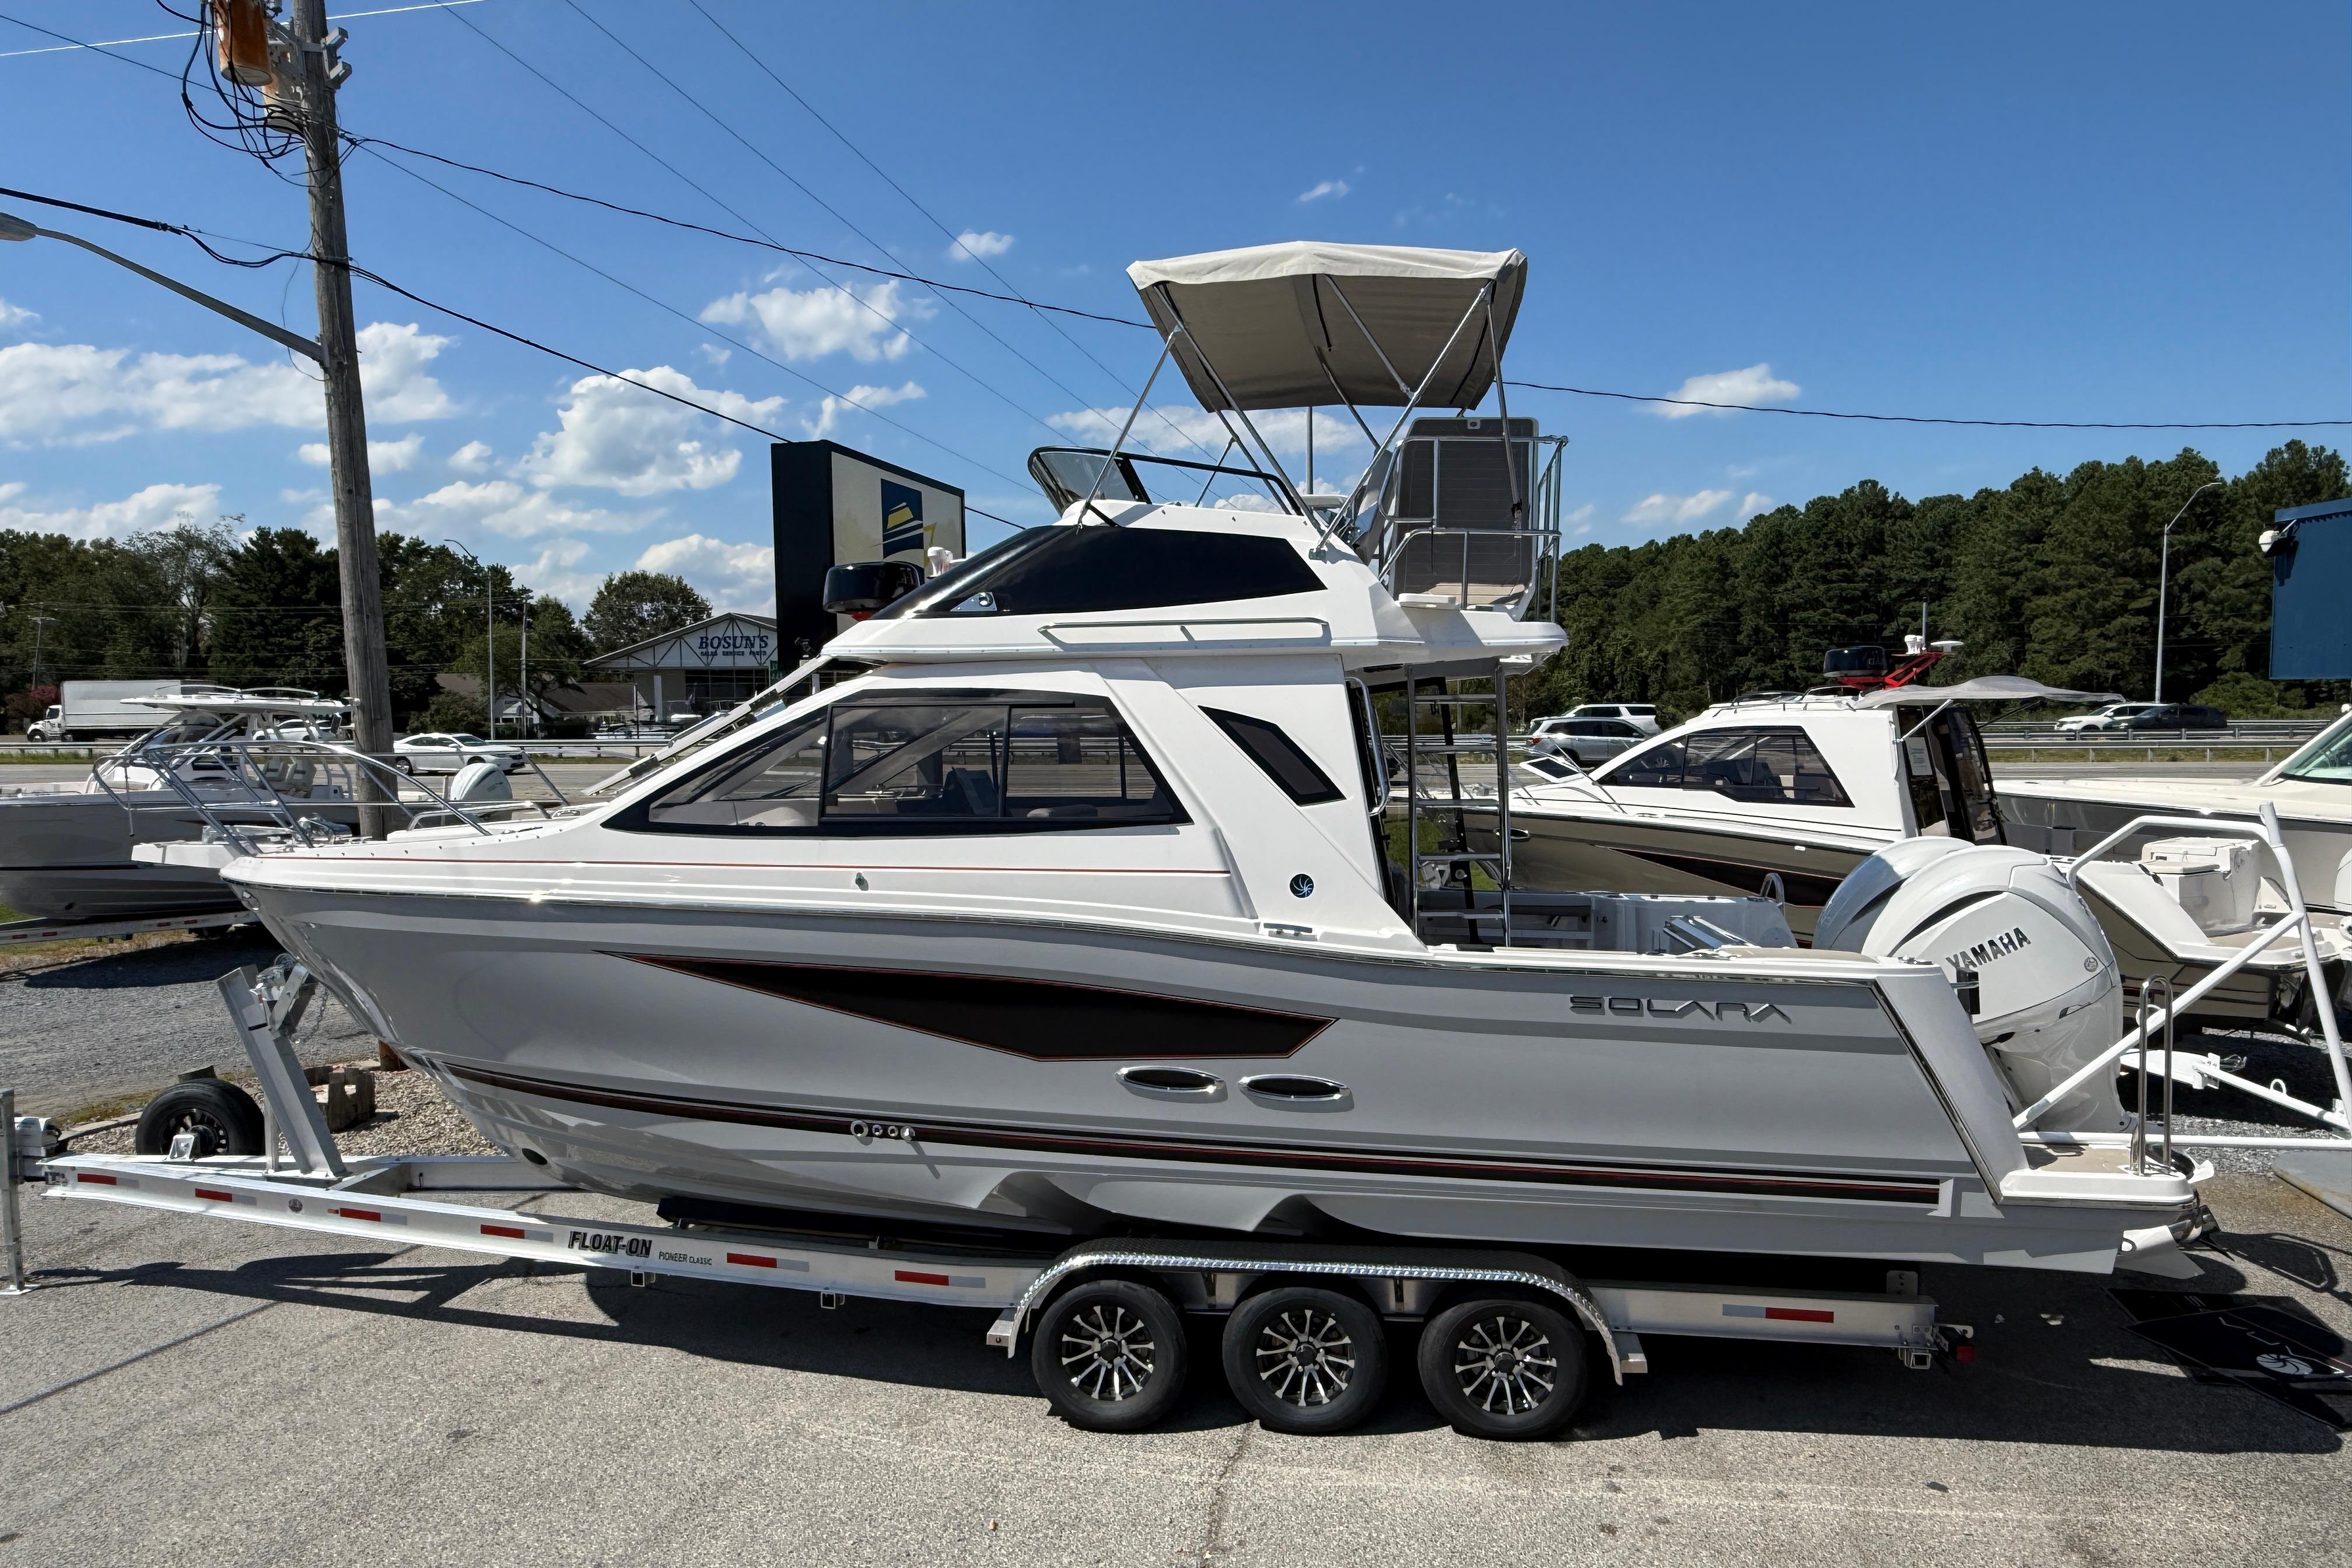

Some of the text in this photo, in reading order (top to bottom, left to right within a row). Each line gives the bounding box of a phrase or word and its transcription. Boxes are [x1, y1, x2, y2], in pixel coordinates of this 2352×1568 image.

[698, 635, 769, 649] BOSUN'S
[1945, 927, 2031, 969] YAMAHA
[1570, 995, 1792, 1024] SOLARA
[568, 1230, 712, 1265] FLOAT-ON PIONEER CLASSIC
